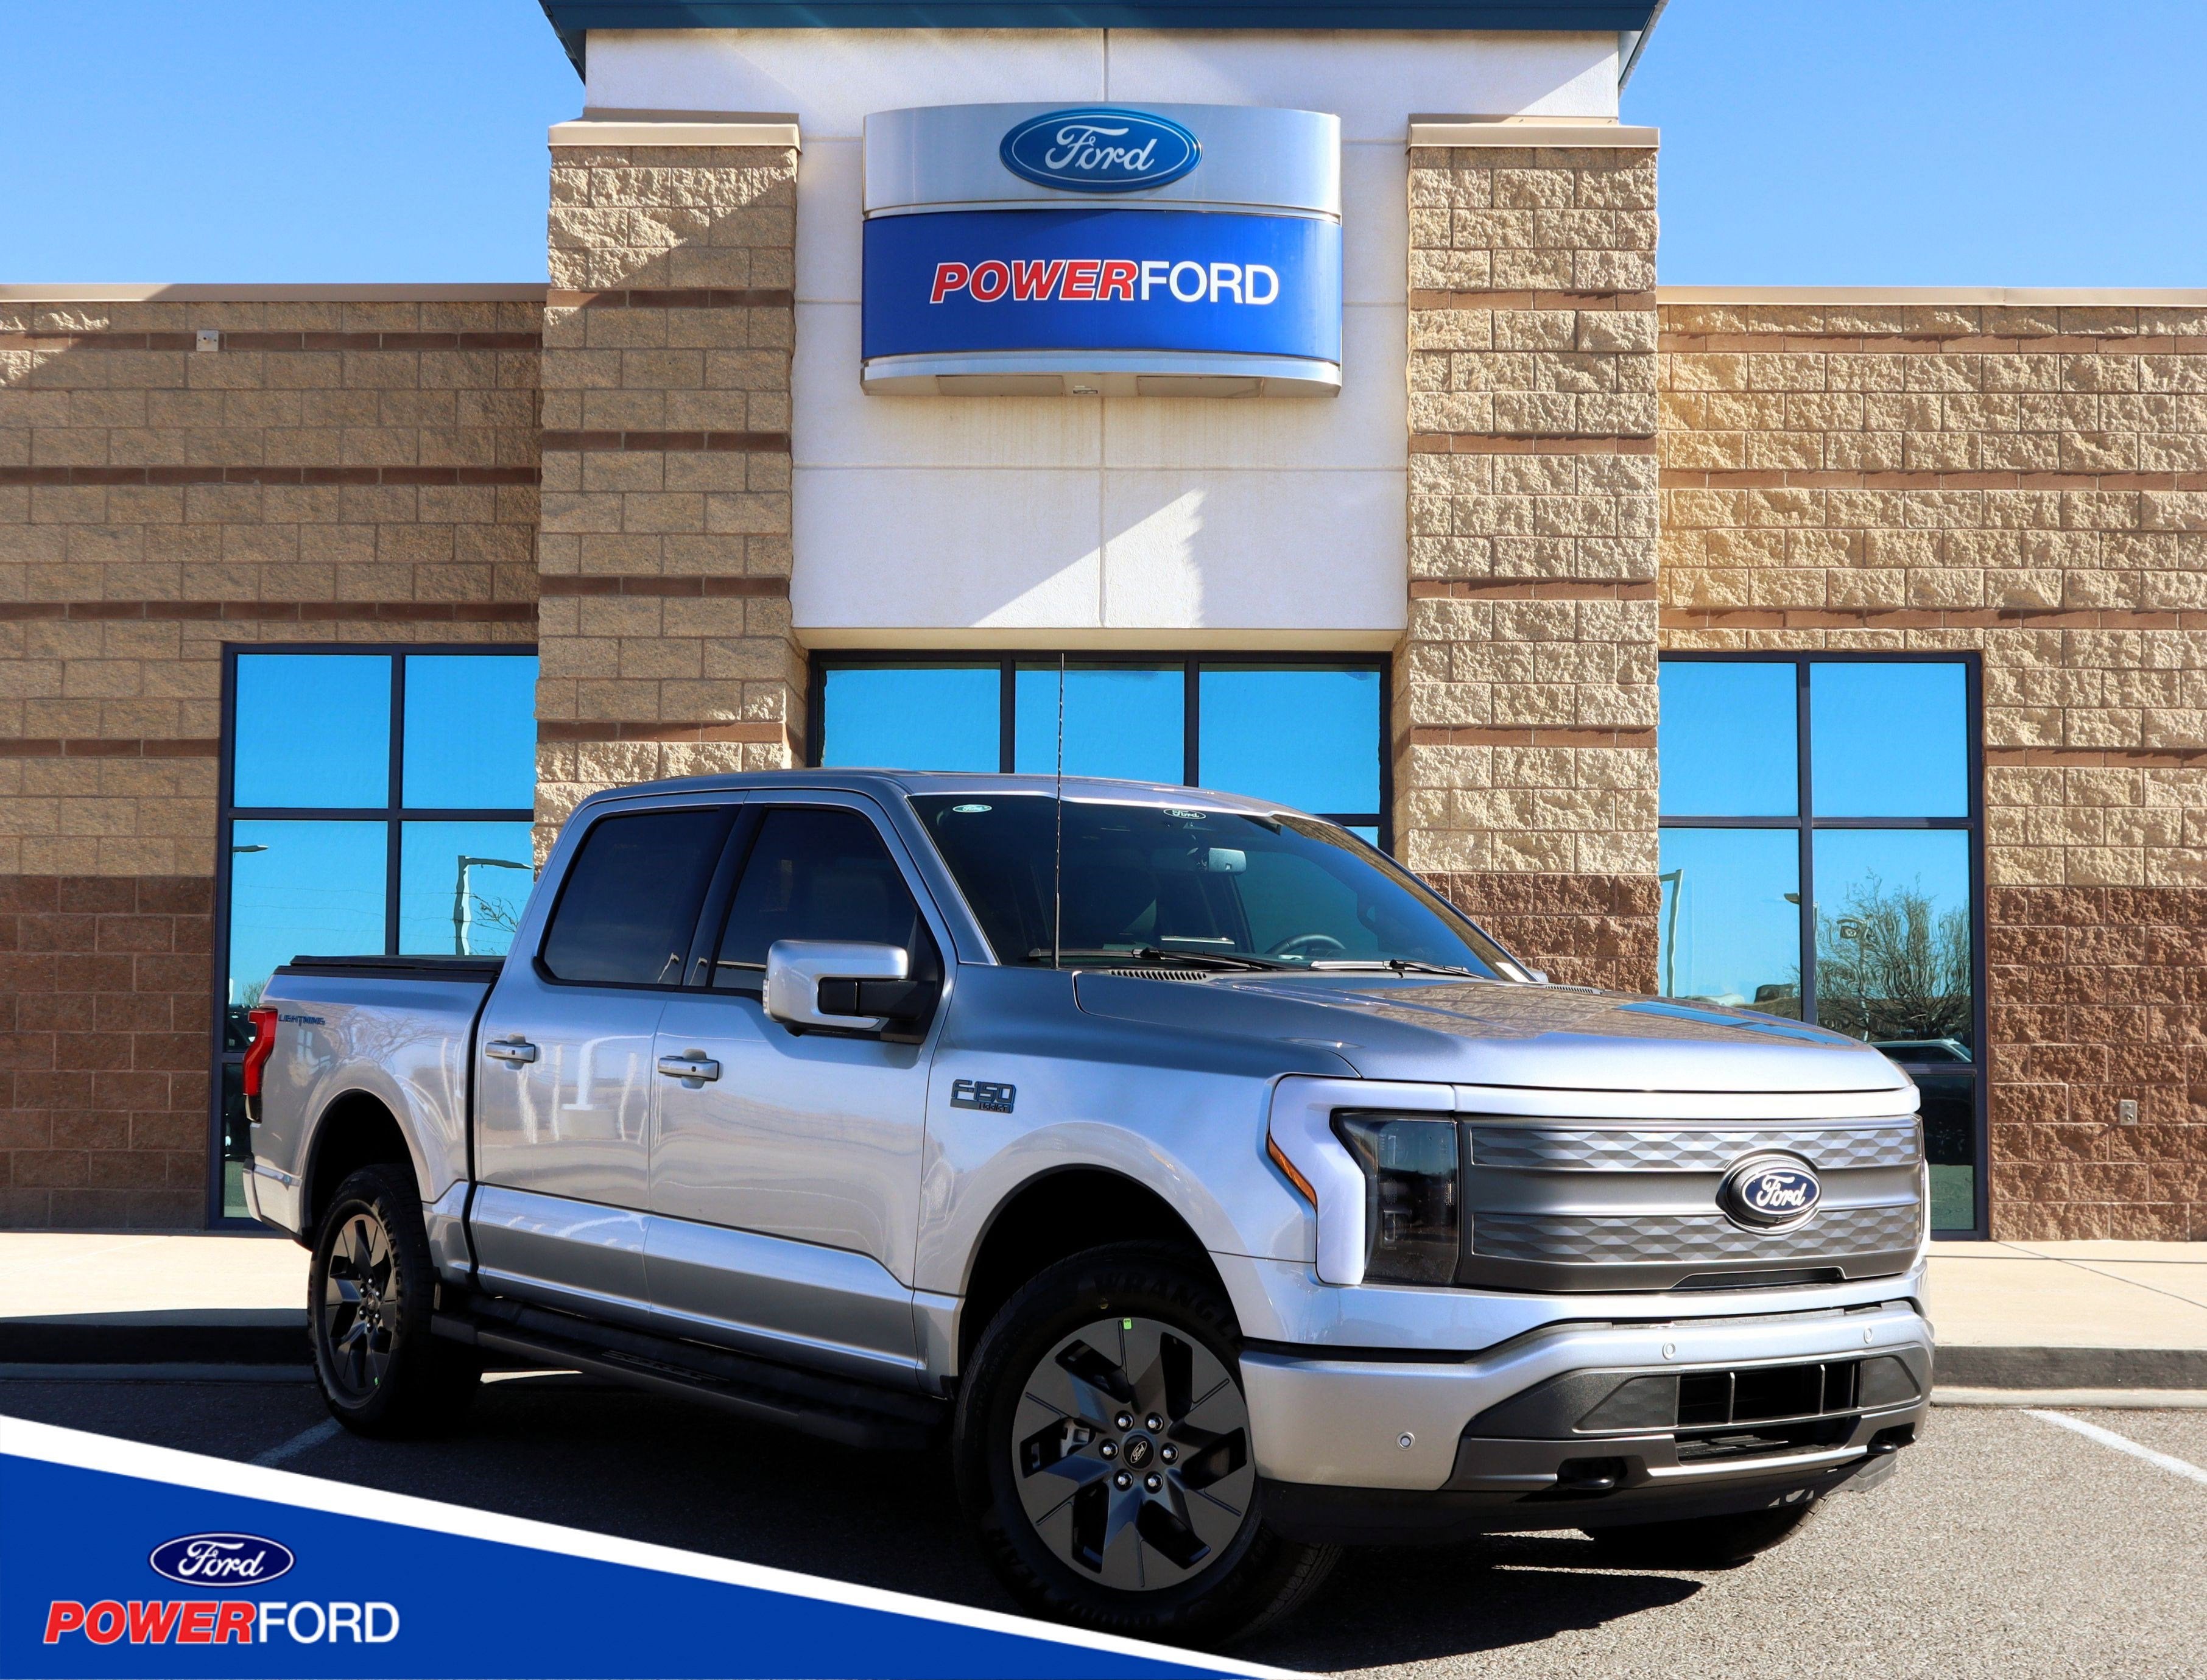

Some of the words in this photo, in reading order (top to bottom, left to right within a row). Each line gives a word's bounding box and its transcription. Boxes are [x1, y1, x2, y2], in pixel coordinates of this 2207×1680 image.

[1045, 124, 1156, 171] Ford
[1172, 809, 1200, 818] Ford
[278, 1014, 325, 1027] LIGHTNING
[951, 1079, 1016, 1103] F-150
[1756, 1175, 1807, 1207] Ford
[1133, 1444, 1145, 1461] Ford
